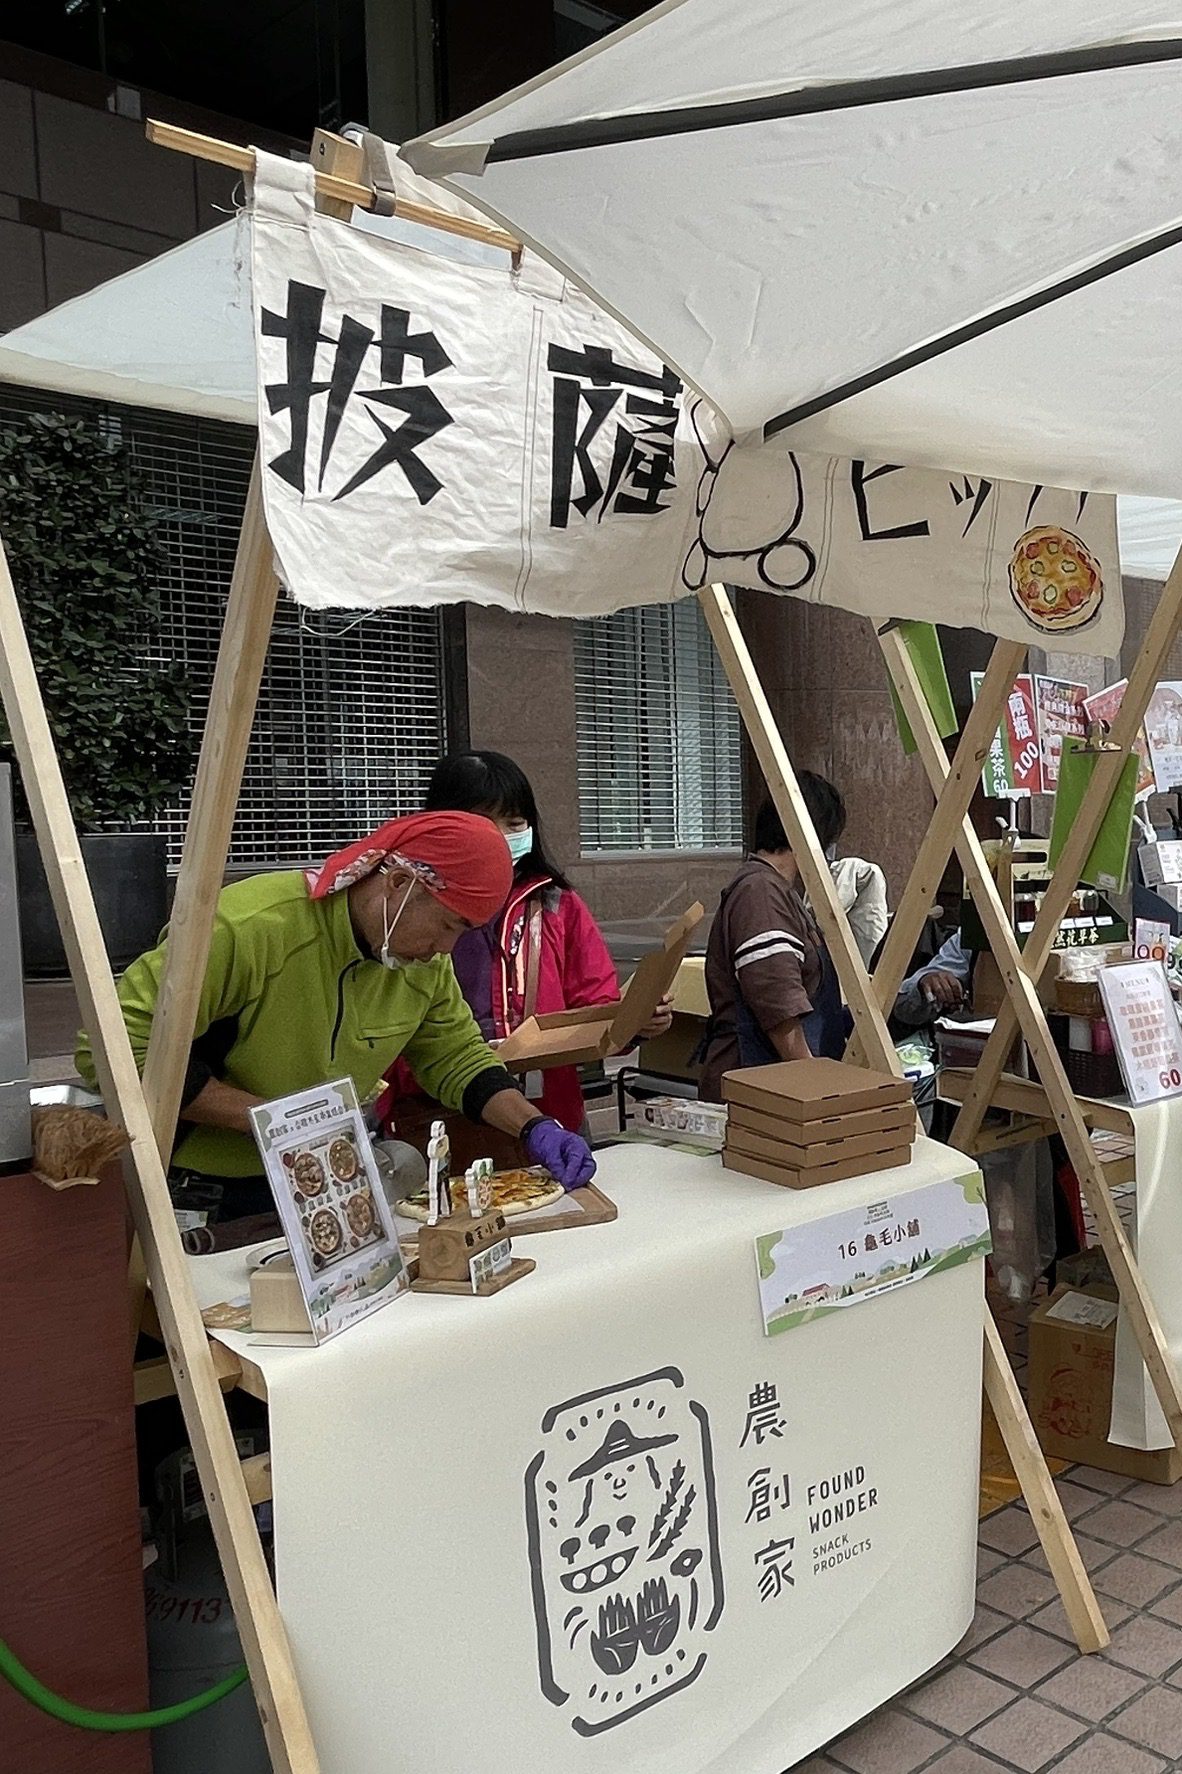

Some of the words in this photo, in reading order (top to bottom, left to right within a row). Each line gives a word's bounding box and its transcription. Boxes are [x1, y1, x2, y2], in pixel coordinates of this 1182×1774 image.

[261, 280, 683, 528] 披薩
[1014, 741, 1038, 779] 100
[993, 779, 1008, 792] 60
[1050, 928, 1100, 949] 然花草茶
[1159, 1068, 1181, 1089] 60
[838, 1241, 857, 1259] 16
[739, 1381, 796, 1603] 農創家
[807, 1465, 866, 1506] FOUND
[808, 1488, 879, 1534] WONDER
[812, 1534, 850, 1559] SNACK
[812, 1538, 872, 1575] PRODUCTS
